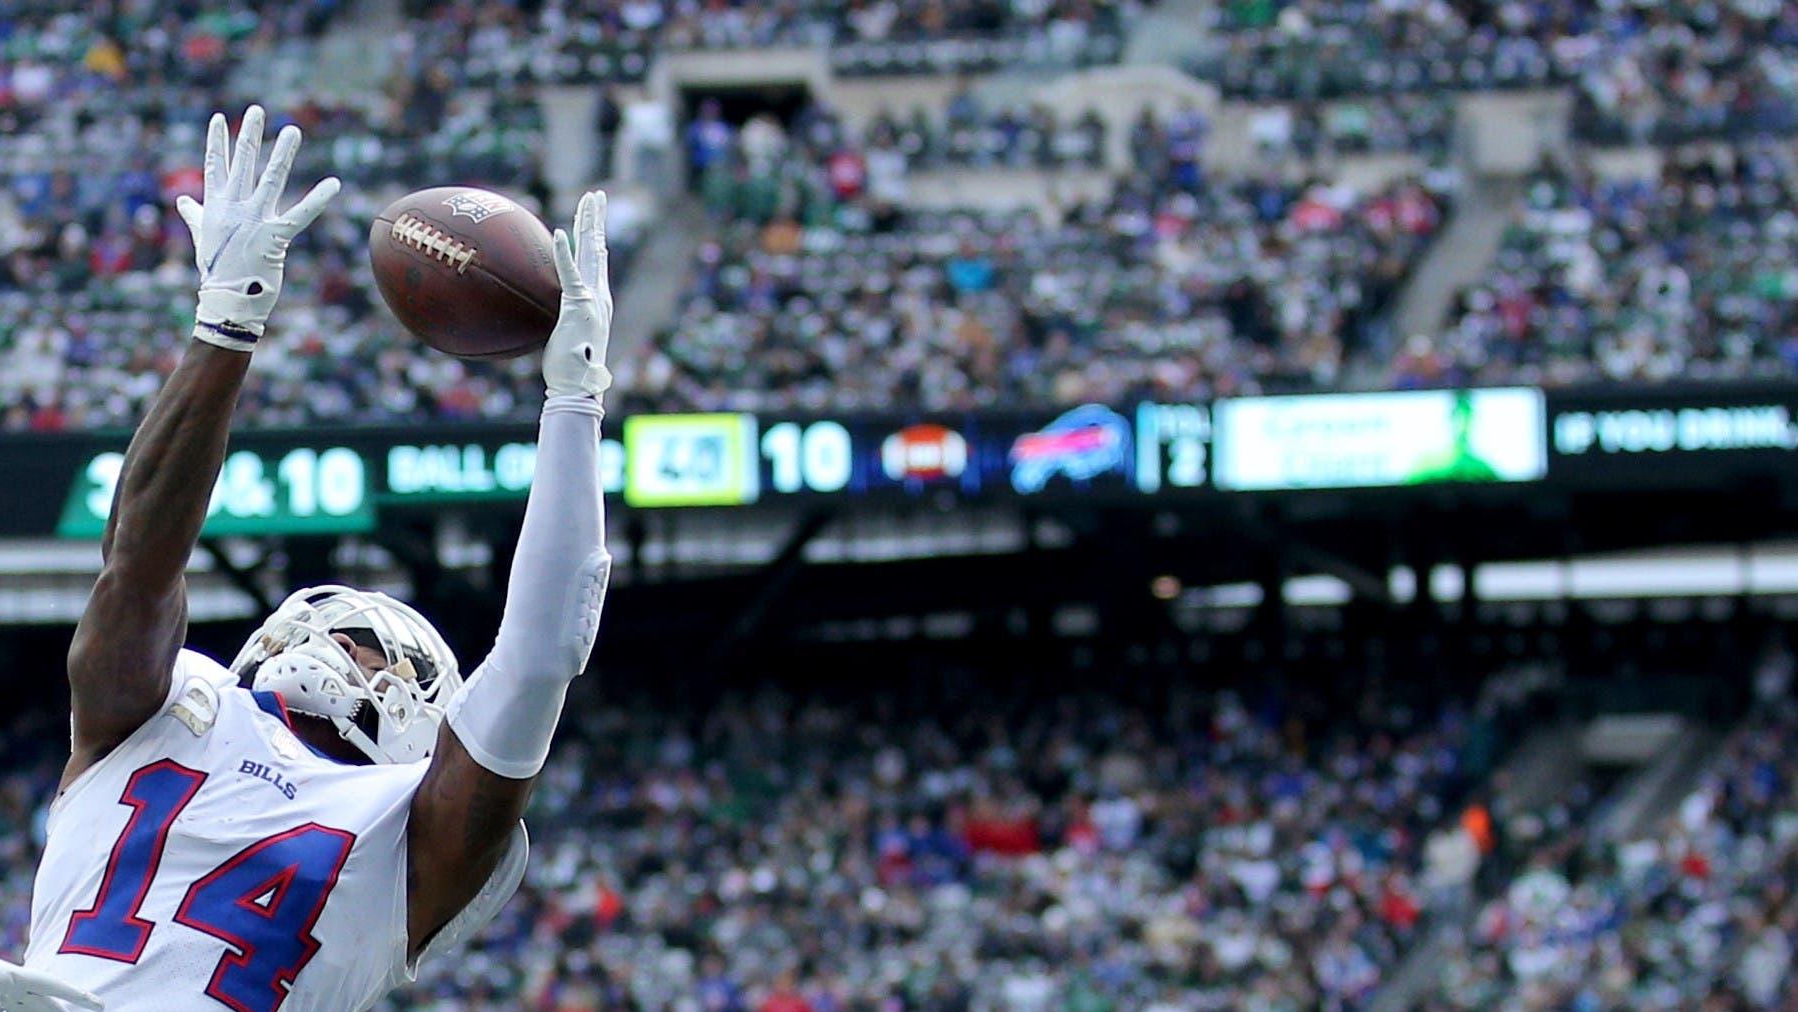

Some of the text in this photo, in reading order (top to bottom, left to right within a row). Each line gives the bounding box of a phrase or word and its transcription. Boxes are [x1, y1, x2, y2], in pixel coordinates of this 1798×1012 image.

[1596, 408, 1675, 453] YOU
[388, 444, 495, 493] BALL
[759, 421, 852, 493] 10
[277, 447, 365, 517] 10
[238, 759, 298, 801] BILLS
